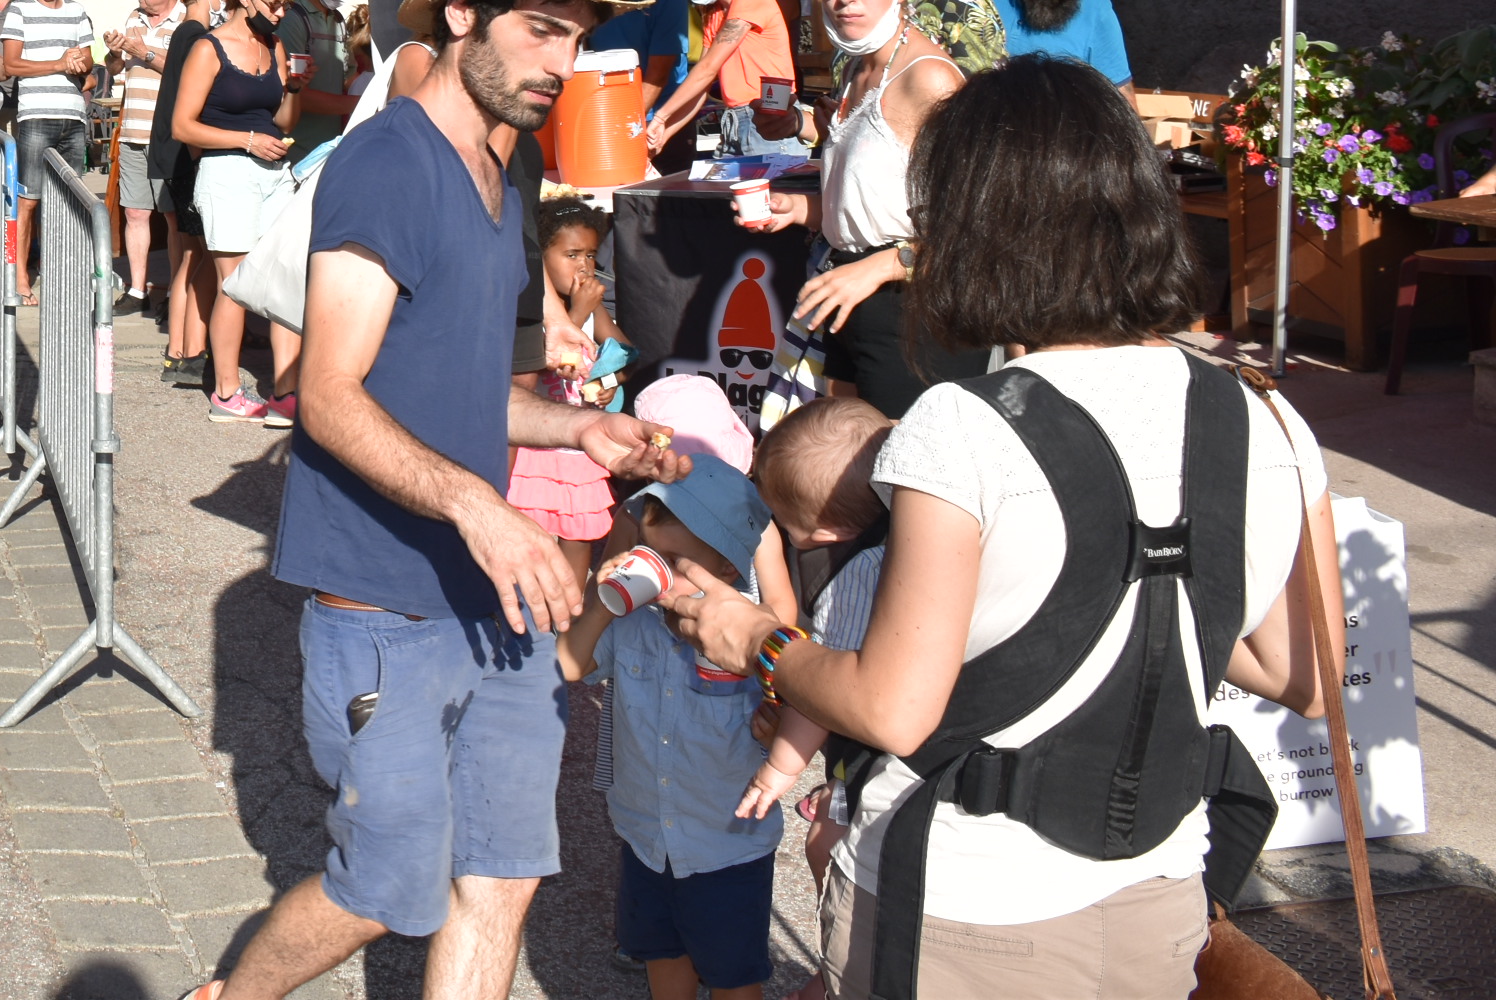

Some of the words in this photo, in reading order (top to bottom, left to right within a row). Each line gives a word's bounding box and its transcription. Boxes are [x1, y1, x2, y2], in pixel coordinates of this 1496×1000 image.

[1254, 748, 1285, 763] et's
[1289, 747, 1315, 759] not
[1280, 762, 1364, 784] groundg
[1279, 786, 1334, 802] burrow
